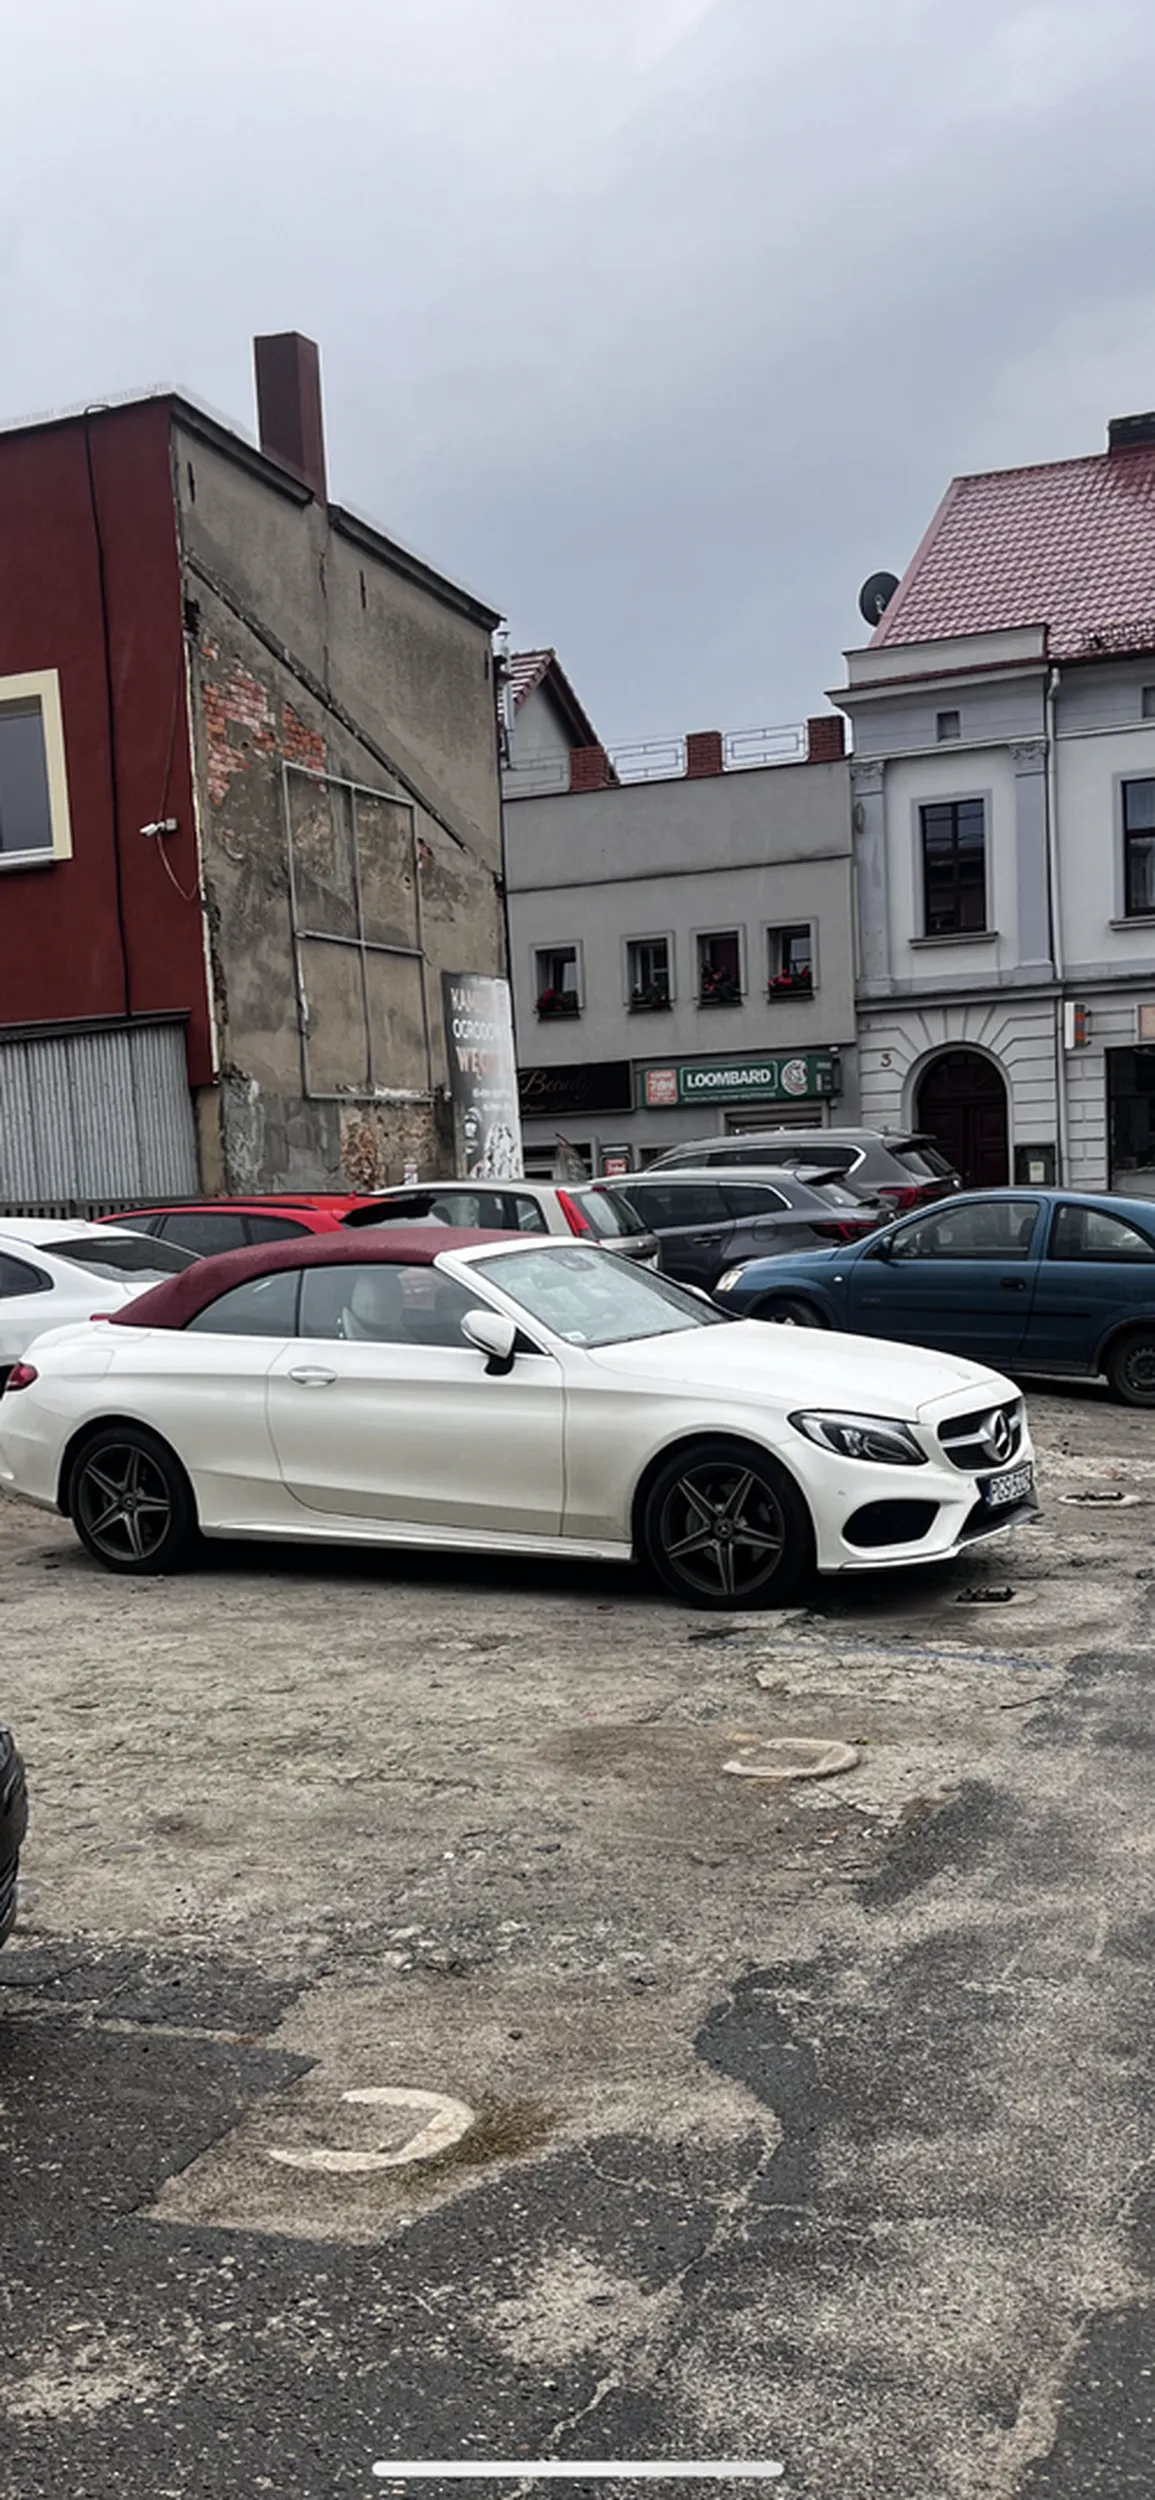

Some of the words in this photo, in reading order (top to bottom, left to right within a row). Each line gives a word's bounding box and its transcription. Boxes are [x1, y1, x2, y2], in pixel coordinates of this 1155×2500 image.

[880, 1053, 892, 1067] 3
[518, 1069, 594, 1100] Beauty
[686, 1069, 771, 1088] LOOMBARD
